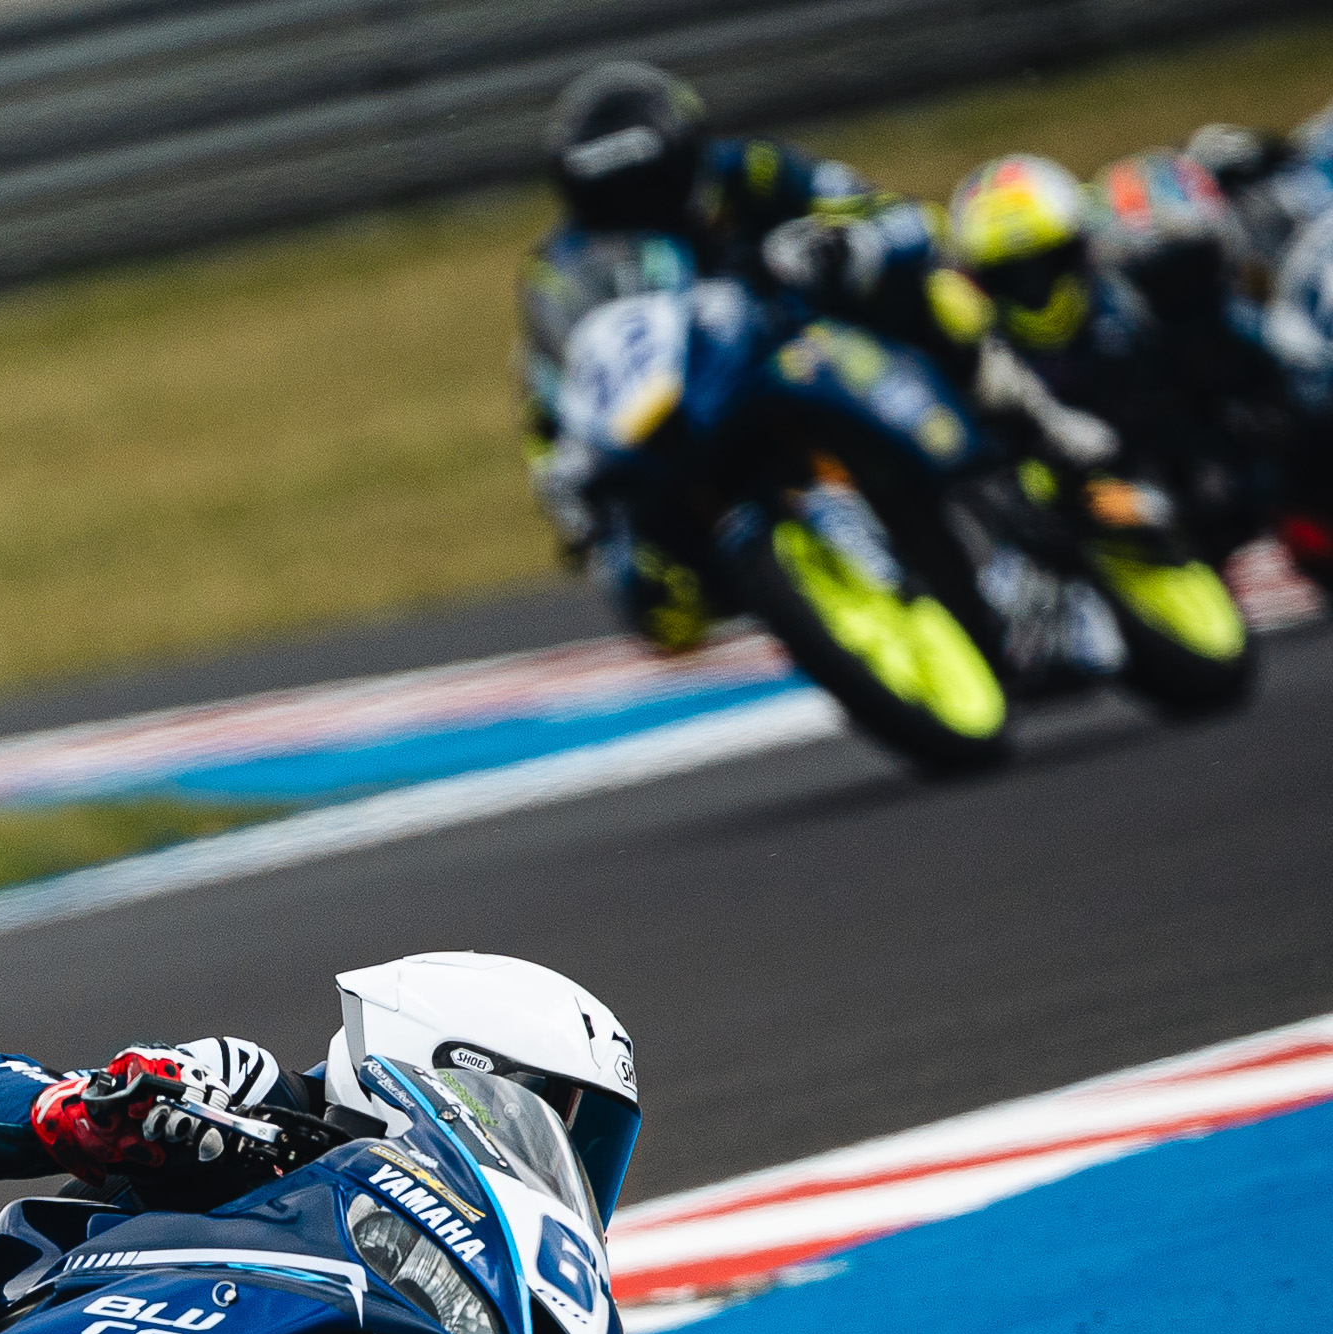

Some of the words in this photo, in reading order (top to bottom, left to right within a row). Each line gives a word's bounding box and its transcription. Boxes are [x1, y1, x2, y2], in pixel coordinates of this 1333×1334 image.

[456, 1052, 487, 1069] SHOEI
[369, 1164, 486, 1263] YAMAHA
[83, 1295, 226, 1330] BLU
